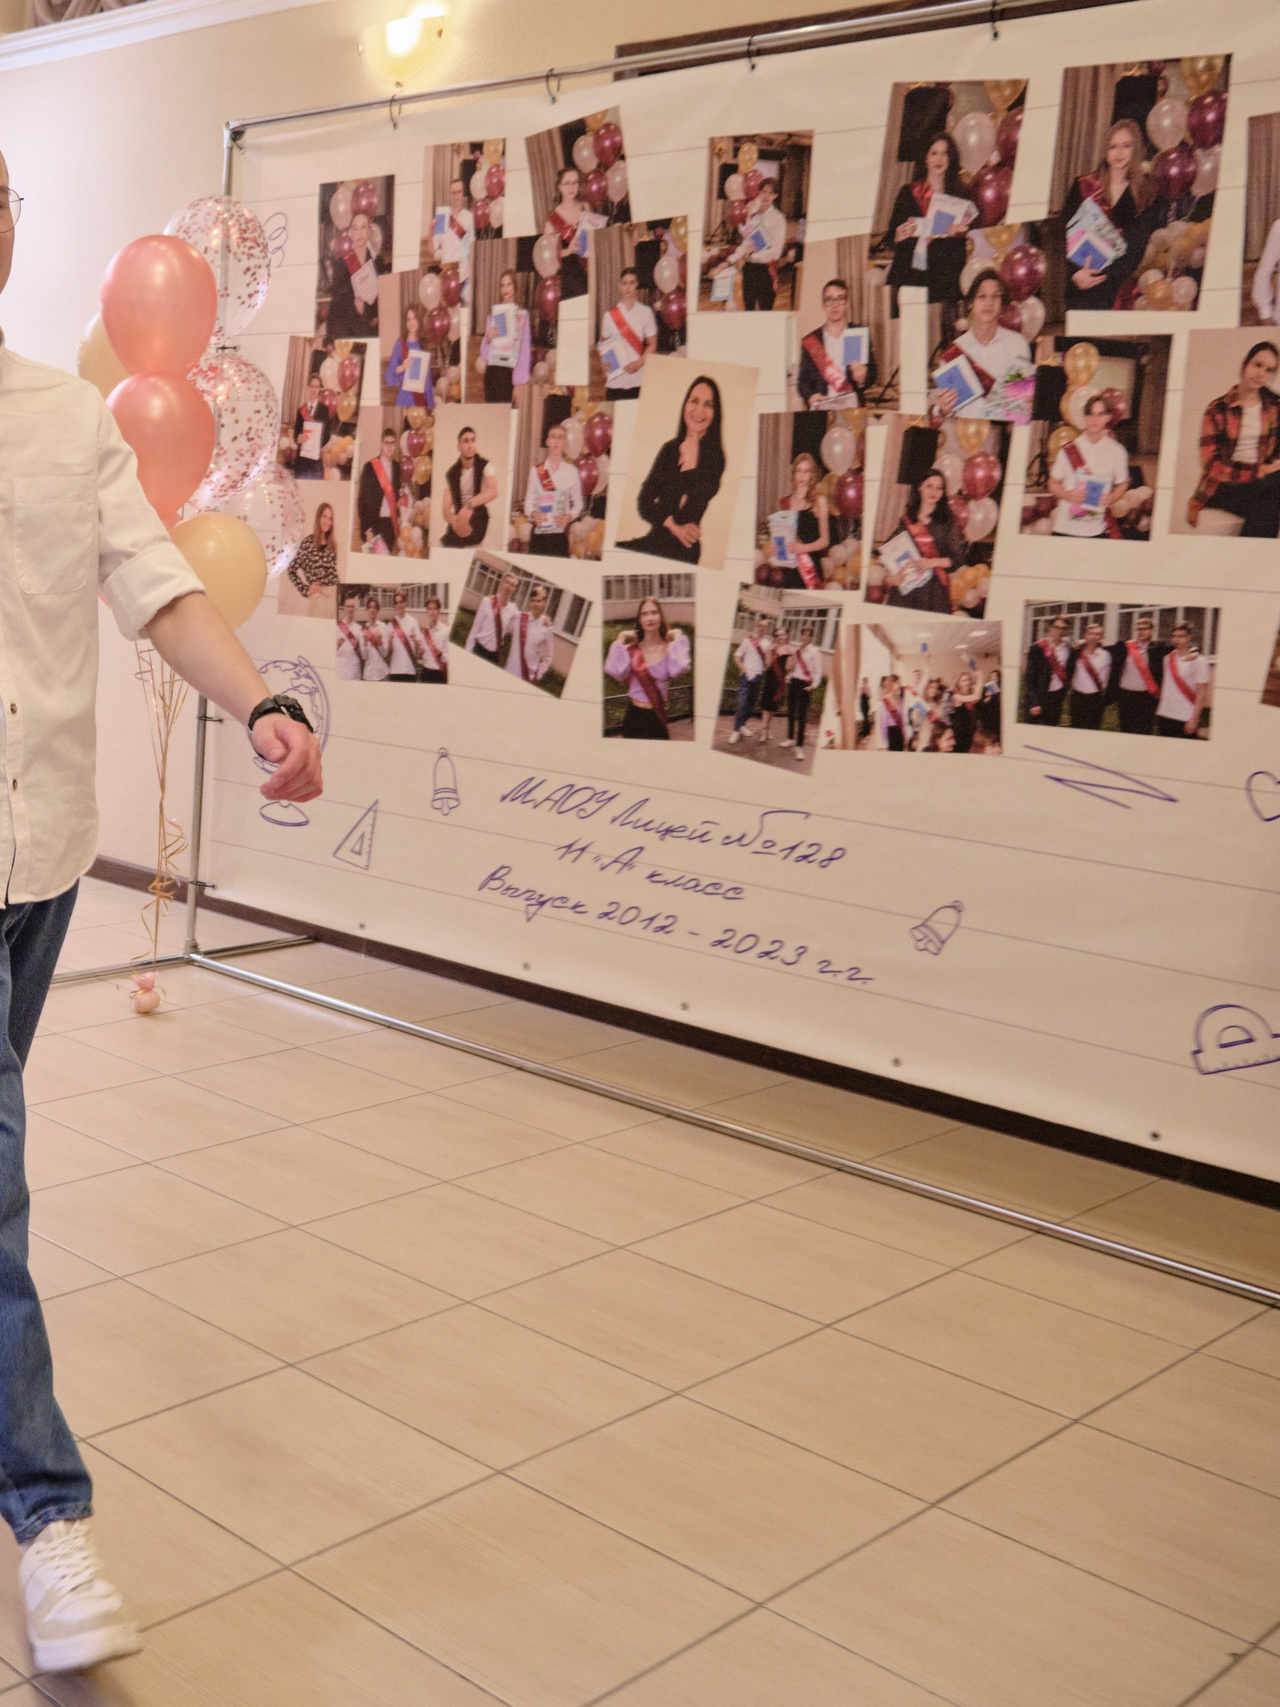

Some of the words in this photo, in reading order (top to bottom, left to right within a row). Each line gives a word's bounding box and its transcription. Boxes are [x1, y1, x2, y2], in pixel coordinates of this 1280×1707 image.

[499, 776, 621, 820] МАОУ
[609, 797, 720, 842] Лицей
[554, 838, 595, 863] 11
[645, 869, 746, 900] класс
[477, 864, 589, 923] Выпуск
[596, 901, 678, 934] 2012
[710, 928, 809, 966] 2023
